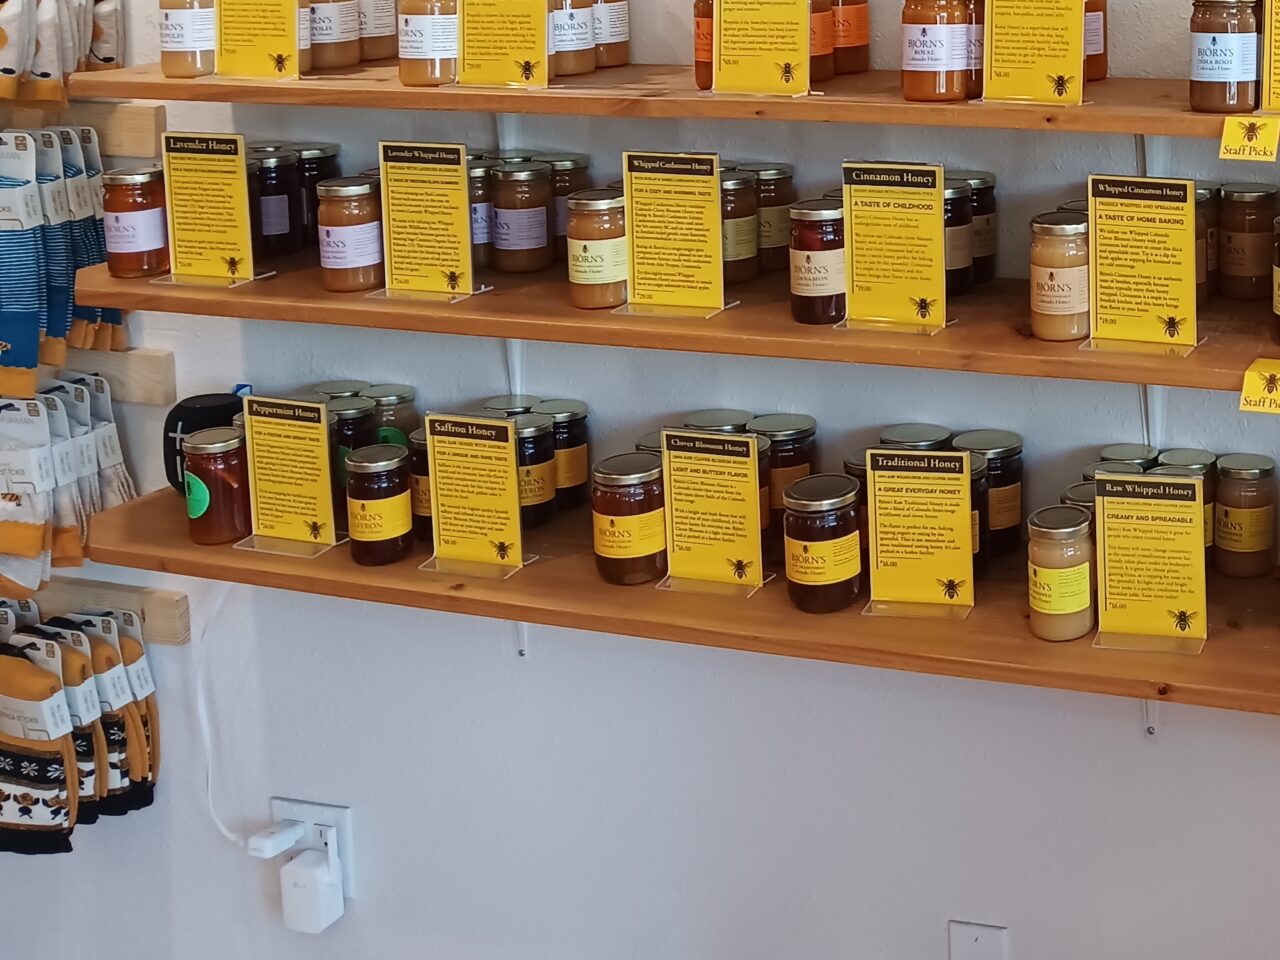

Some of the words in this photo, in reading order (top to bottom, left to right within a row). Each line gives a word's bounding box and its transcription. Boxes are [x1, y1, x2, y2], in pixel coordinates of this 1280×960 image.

[169, 138, 207, 150] Lavender
[208, 140, 235, 153] Honey
[1222, 144, 1248, 156] Staff
[1246, 144, 1274, 157] Picks
[852, 170, 901, 182] Cinnamon
[903, 172, 934, 186] Honey
[1098, 183, 1128, 195] Whipped
[1128, 186, 1163, 195] Cinnamon
[1162, 187, 1184, 198] Honey
[859, 200, 881, 208] TASTE
[882, 201, 892, 209] OF
[892, 201, 934, 211] CHILDHOOD
[1104, 214, 1125, 222] TASTE
[1136, 216, 1157, 224] HOME
[1158, 217, 1185, 226] BAKING
[1242, 395, 1268, 409] Staff
[252, 403, 294, 416] Peppermint
[294, 408, 318, 421] Honey
[434, 422, 466, 434] Saffron
[468, 425, 497, 439] Honey
[670, 438, 694, 447] Clover
[695, 440, 724, 450] Blossom
[724, 443, 747, 454] Honey
[876, 456, 928, 467] Traditional
[930, 458, 961, 471] Honey
[1105, 483, 1124, 492] Raw
[1124, 484, 1164, 496] Whipped
[1165, 486, 1193, 497] Honey
